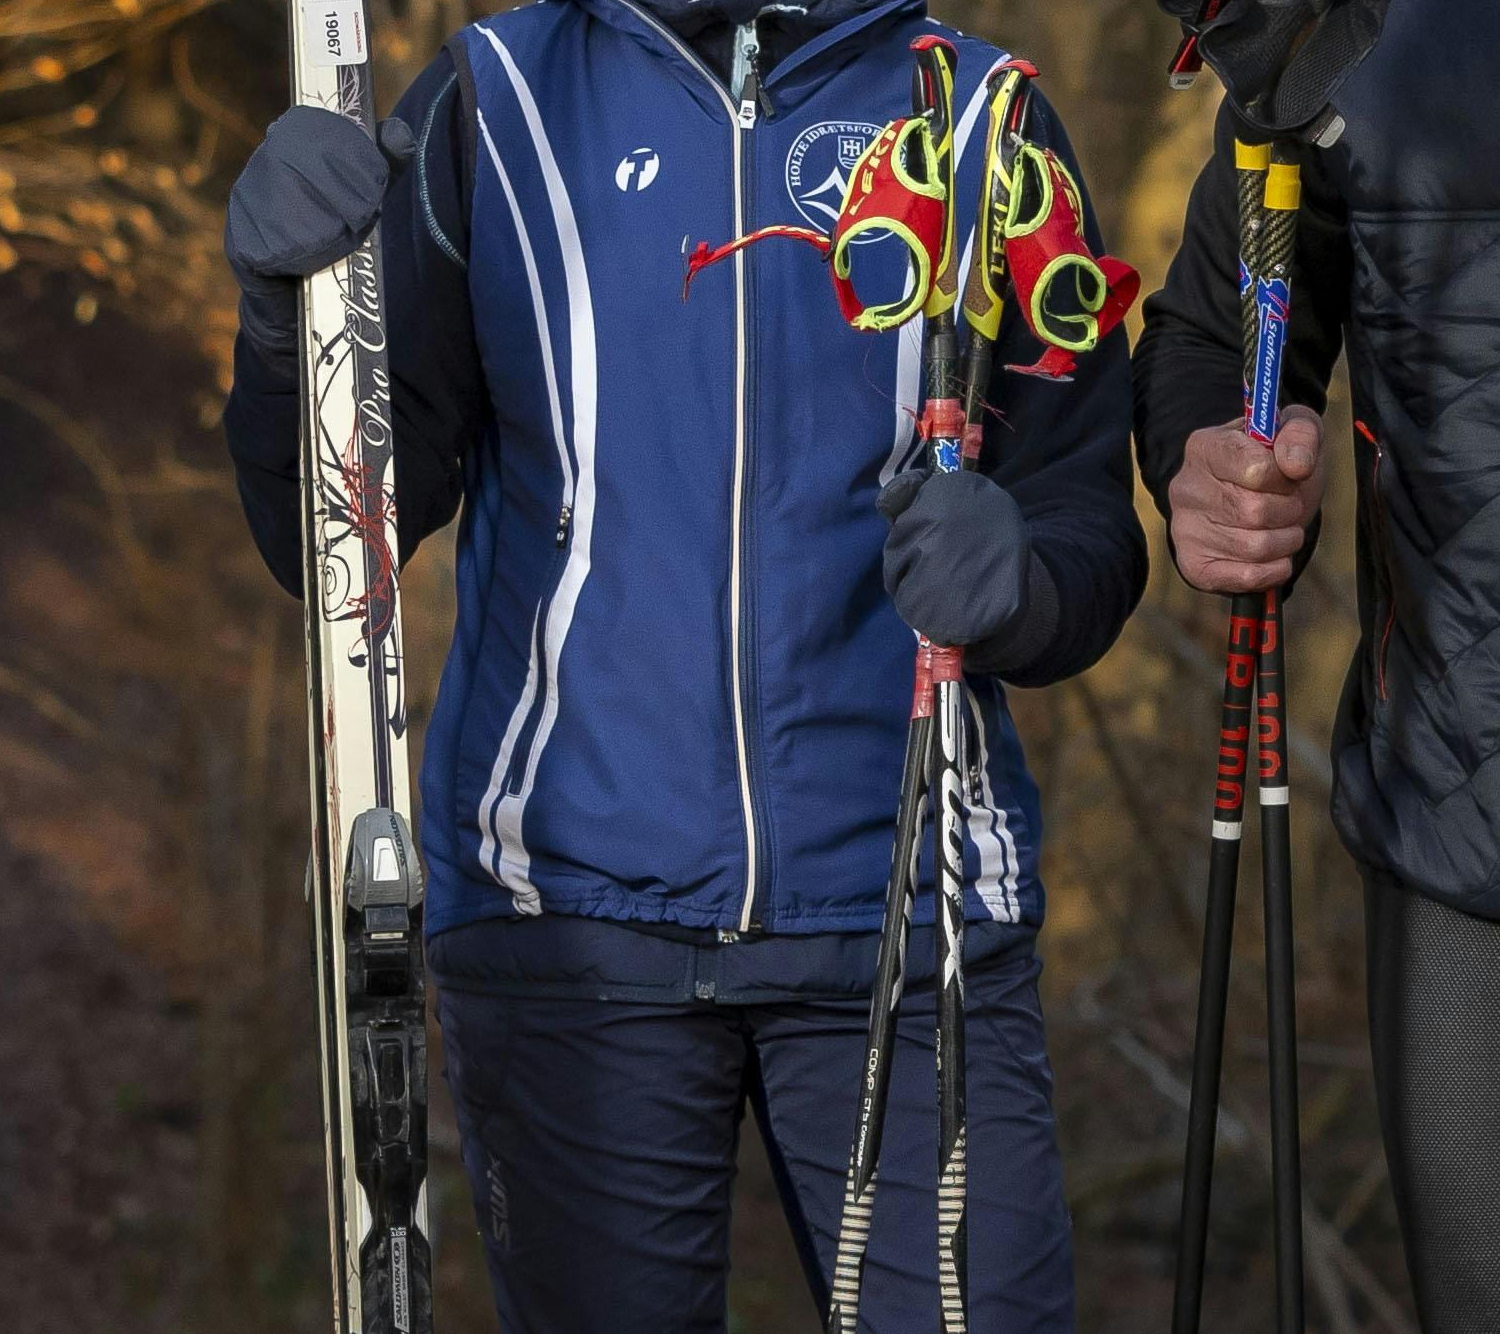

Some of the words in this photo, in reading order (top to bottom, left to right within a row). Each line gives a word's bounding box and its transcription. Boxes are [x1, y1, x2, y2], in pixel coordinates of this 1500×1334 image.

[324, 11, 342, 57] 19067
[790, 140, 810, 187] HOLTE
[848, 130, 897, 216] LEKI
[990, 202, 1009, 275] LEKI
[357, 367, 392, 447] Pro
[388, 811, 406, 867] SALOMON
[866, 1048, 879, 1091] COMP
[394, 1268, 402, 1325] SALOMON
